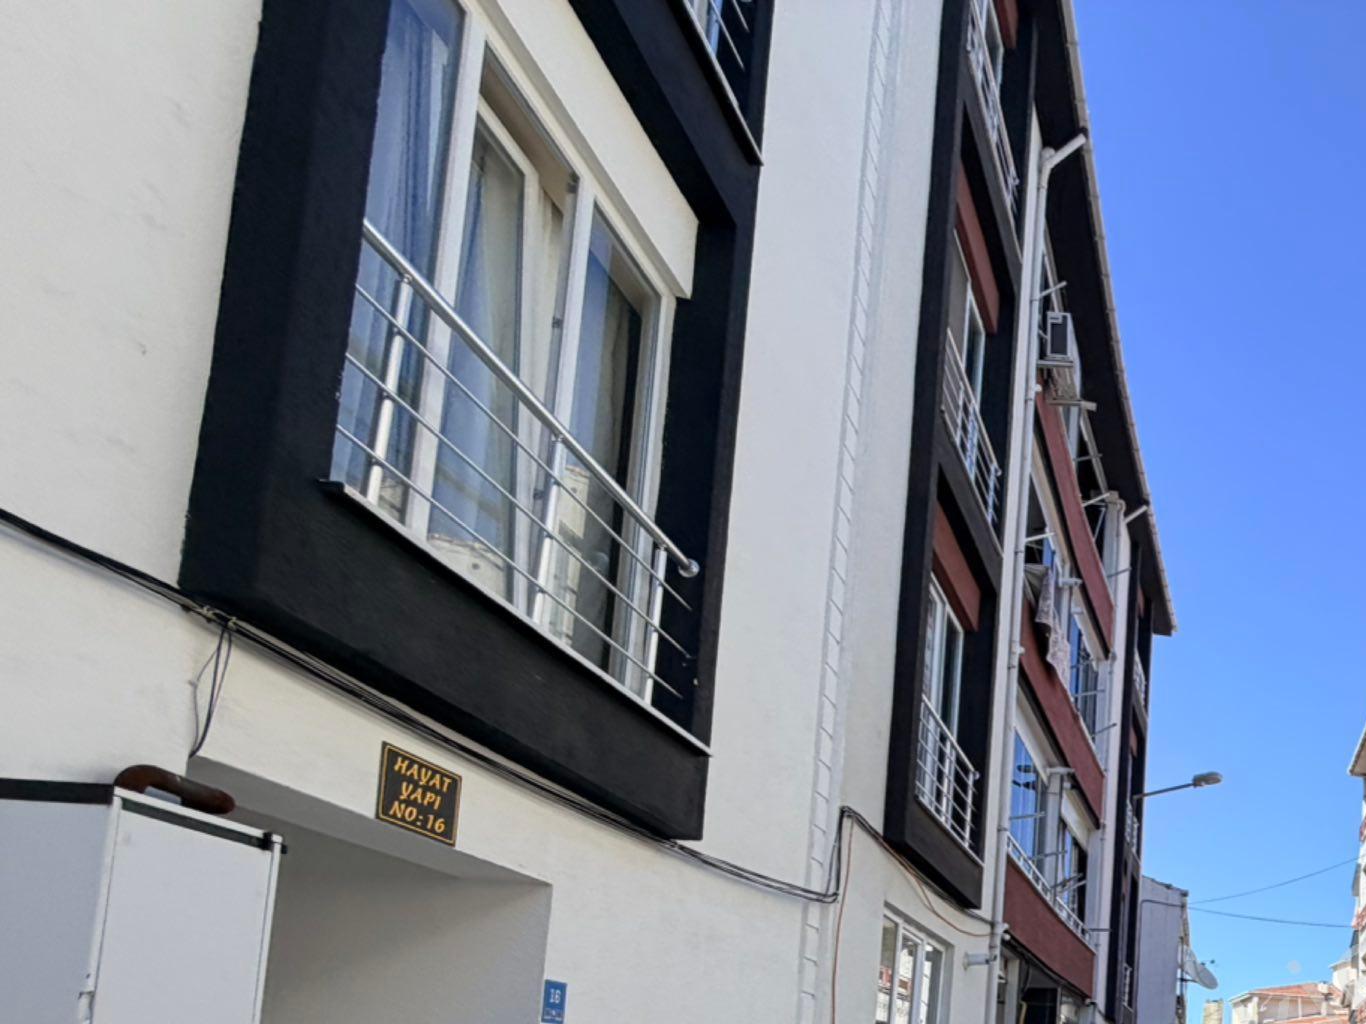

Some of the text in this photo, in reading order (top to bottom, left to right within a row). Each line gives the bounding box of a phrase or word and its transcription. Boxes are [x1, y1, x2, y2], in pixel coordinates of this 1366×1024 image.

[394, 757, 452, 792] HAYAT
[400, 781, 441, 810] YAPI
[389, 801, 445, 833] NO:16
